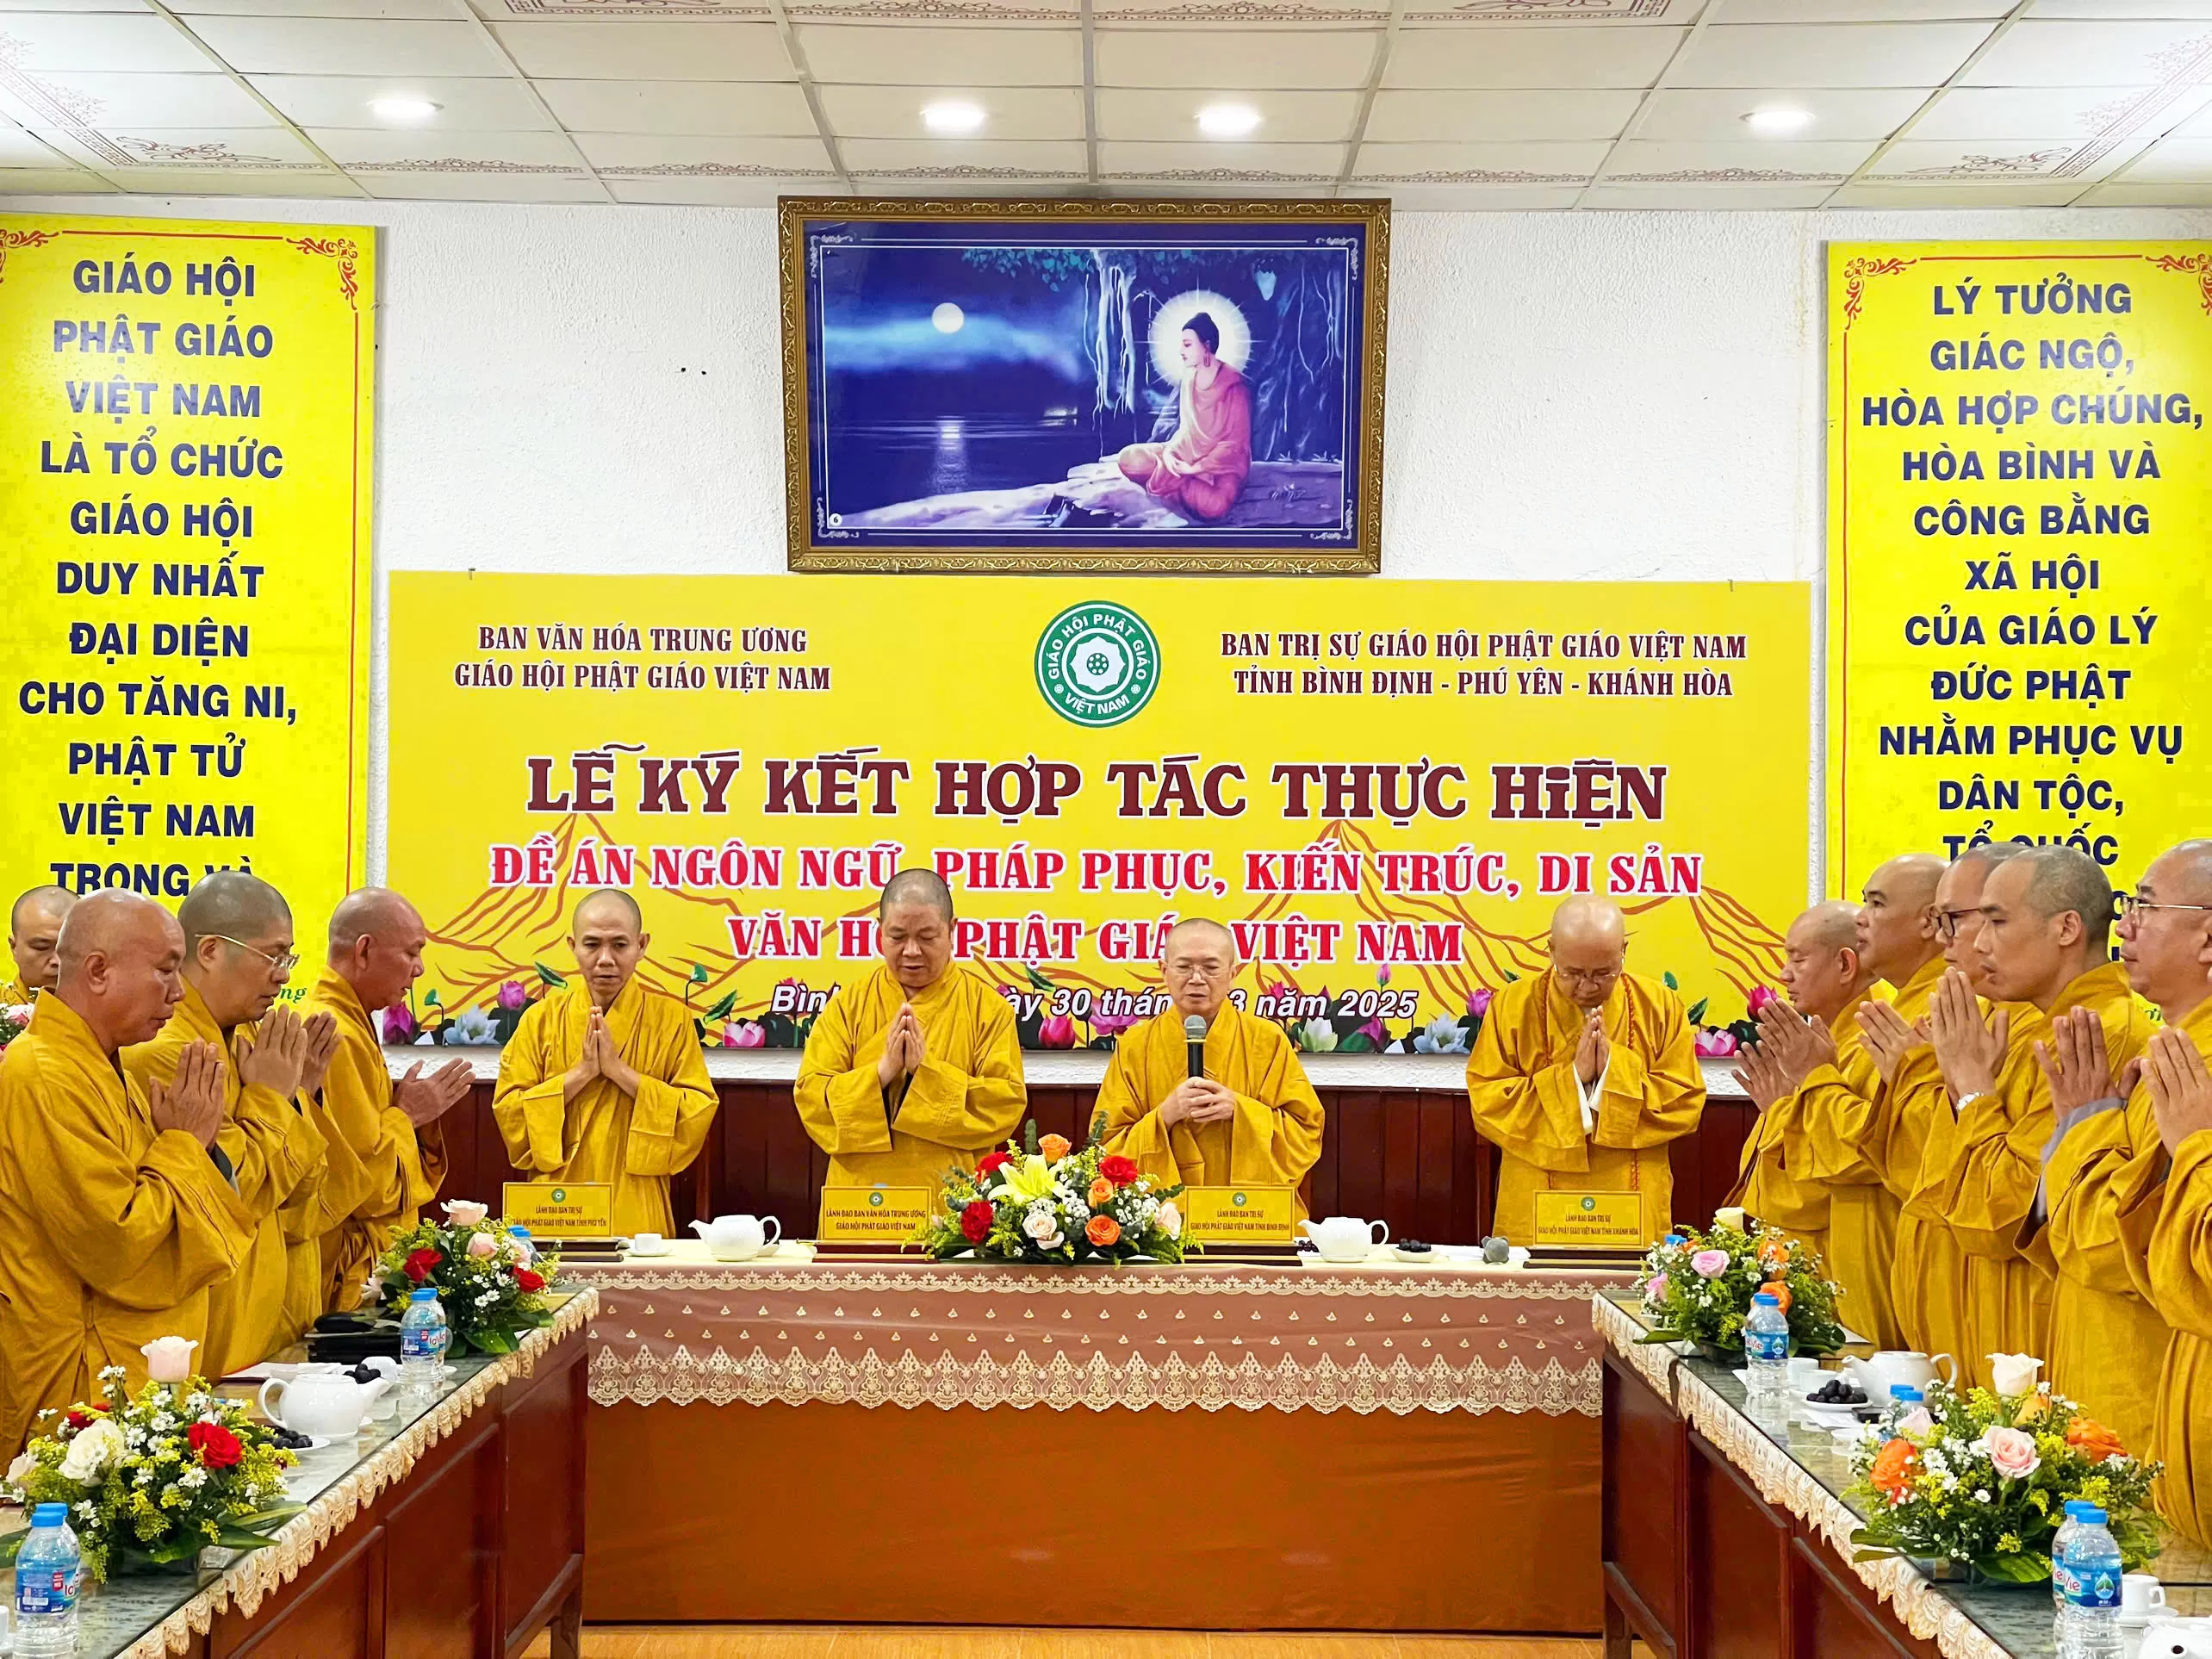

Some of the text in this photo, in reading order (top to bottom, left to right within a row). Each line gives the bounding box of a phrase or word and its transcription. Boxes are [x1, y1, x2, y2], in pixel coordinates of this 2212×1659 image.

[74, 253, 254, 306] GIÁO HỘI
[1935, 273, 2130, 314] LÝ TƯỞNG
[54, 314, 272, 363] PHẬT GIÁO
[1931, 332, 2130, 377] GIÁC NGỘ,
[66, 375, 259, 423] VIỆT NAM
[1863, 386, 2202, 433] HÒA HỢP CHÚNG,
[42, 426, 283, 478] LÀ TỔ CHỨC
[1904, 442, 2159, 481] HÒA BÌNH VÀ
[71, 494, 252, 547] GIÁO HỘI
[1915, 493, 2149, 536] CÔNG BẰNG
[58, 551, 264, 597] DUY NHẤT
[1966, 552, 2098, 598] XÃ HỘI
[70, 618, 247, 666] ĐẠI DIỆN
[480, 624, 806, 652] BAN VĂN HÓA TRUNG ƯƠNG
[1047, 613, 1149, 680] GIÁO HỘI PHẬT GIÁO
[1222, 631, 1745, 662] BAN TRỊ SỰ GIÁO HỘI PHẬT GIÁO VIỆT NAM
[1905, 605, 2156, 645] CỦA GIÁO LÝ
[456, 660, 830, 693] GIÁO HỘI PHẬT GIÁO VIỆT NAM
[1234, 671, 1292, 693] TỈNH
[1302, 672, 1362, 693] BÌNH
[1372, 672, 1432, 697] ĐỊNH
[1458, 673, 1507, 694] PHÚ
[1517, 668, 1563, 694] YÊN
[1588, 668, 1673, 695] KHÁNH
[1684, 674, 1732, 695] HÒA
[1931, 662, 2131, 708] ĐỨC PHẬT
[20, 676, 295, 724] CHO TĂNG NI,
[1065, 693, 1130, 714] VIỆT NAM
[70, 733, 245, 785] PHẬT TỬ
[1880, 713, 2182, 764] NHẰM PHỤC VỤ
[528, 744, 645, 811] LỄ
[640, 751, 739, 812] KÝ
[765, 748, 909, 813] KẾT
[935, 755, 1080, 823] HỢP
[1108, 755, 1245, 816] TÁC
[1272, 757, 1465, 827] THỰC
[1940, 774, 2122, 818] DÂN TỘC,
[59, 796, 253, 845] VIỆT NAM
[493, 836, 552, 883] ĐỀ
[572, 841, 632, 884] ÁN
[653, 842, 780, 885] NGÔN
[935, 845, 1063, 888] PHÁP
[1083, 854, 1224, 896] PHỤC,
[1246, 842, 1360, 890] KIẾN
[1379, 847, 1518, 896] TRÚC,
[1540, 856, 1589, 892] DI
[1612, 846, 1700, 892] SẢN
[730, 913, 820, 955] VĂN
[954, 915, 1081, 965] PHẬT
[1233, 916, 1339, 966] VIỆT
[1358, 925, 1460, 960] NAM
[771, 984, 841, 1013] Bìn
[1051, 988, 1092, 1016] 30
[1100, 988, 1173, 1016] thán
[1256, 989, 1327, 1017] năm
[1338, 991, 1418, 1018] 2025
